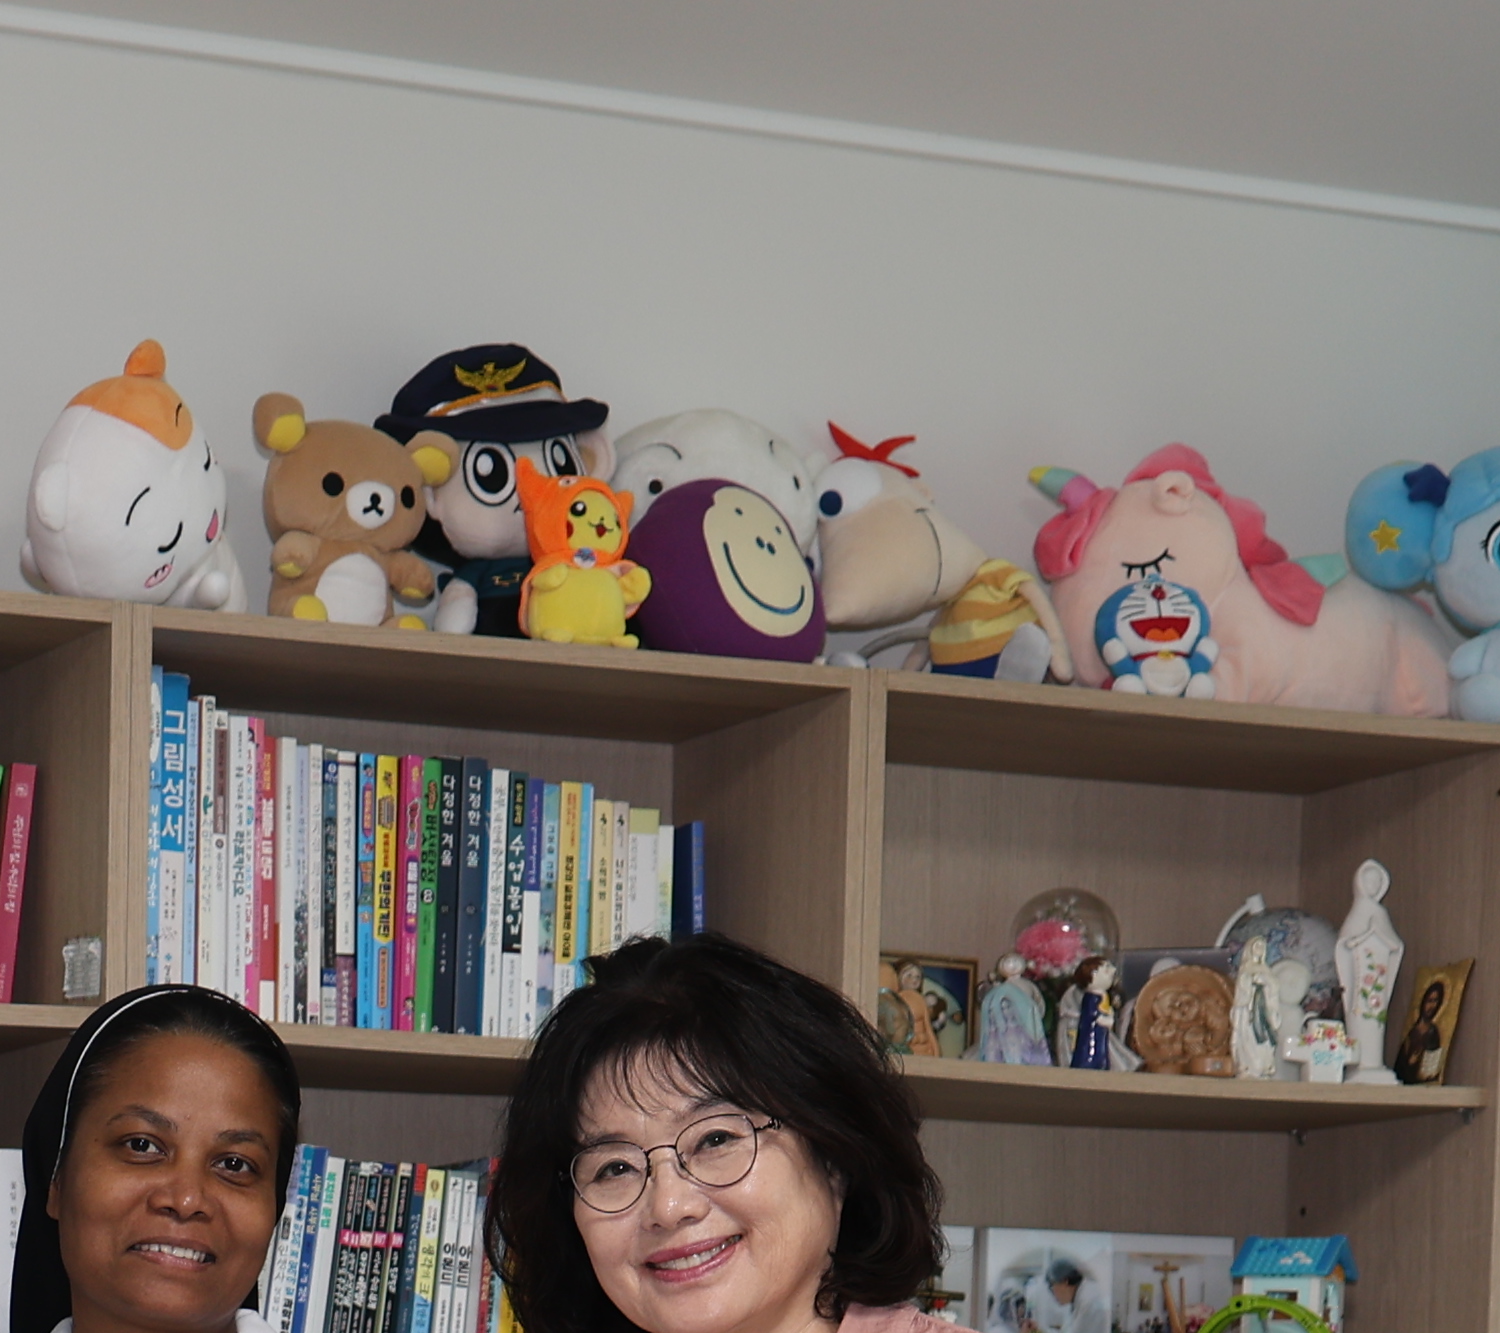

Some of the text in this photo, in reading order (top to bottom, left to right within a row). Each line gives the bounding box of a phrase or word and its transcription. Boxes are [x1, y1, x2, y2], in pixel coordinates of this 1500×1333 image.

[162, 710, 187, 845] 그림성서
[442, 774, 456, 826] 다정한
[468, 775, 482, 827] 다정한
[441, 833, 454, 867] 겨울
[467, 833, 481, 867] 겨울
